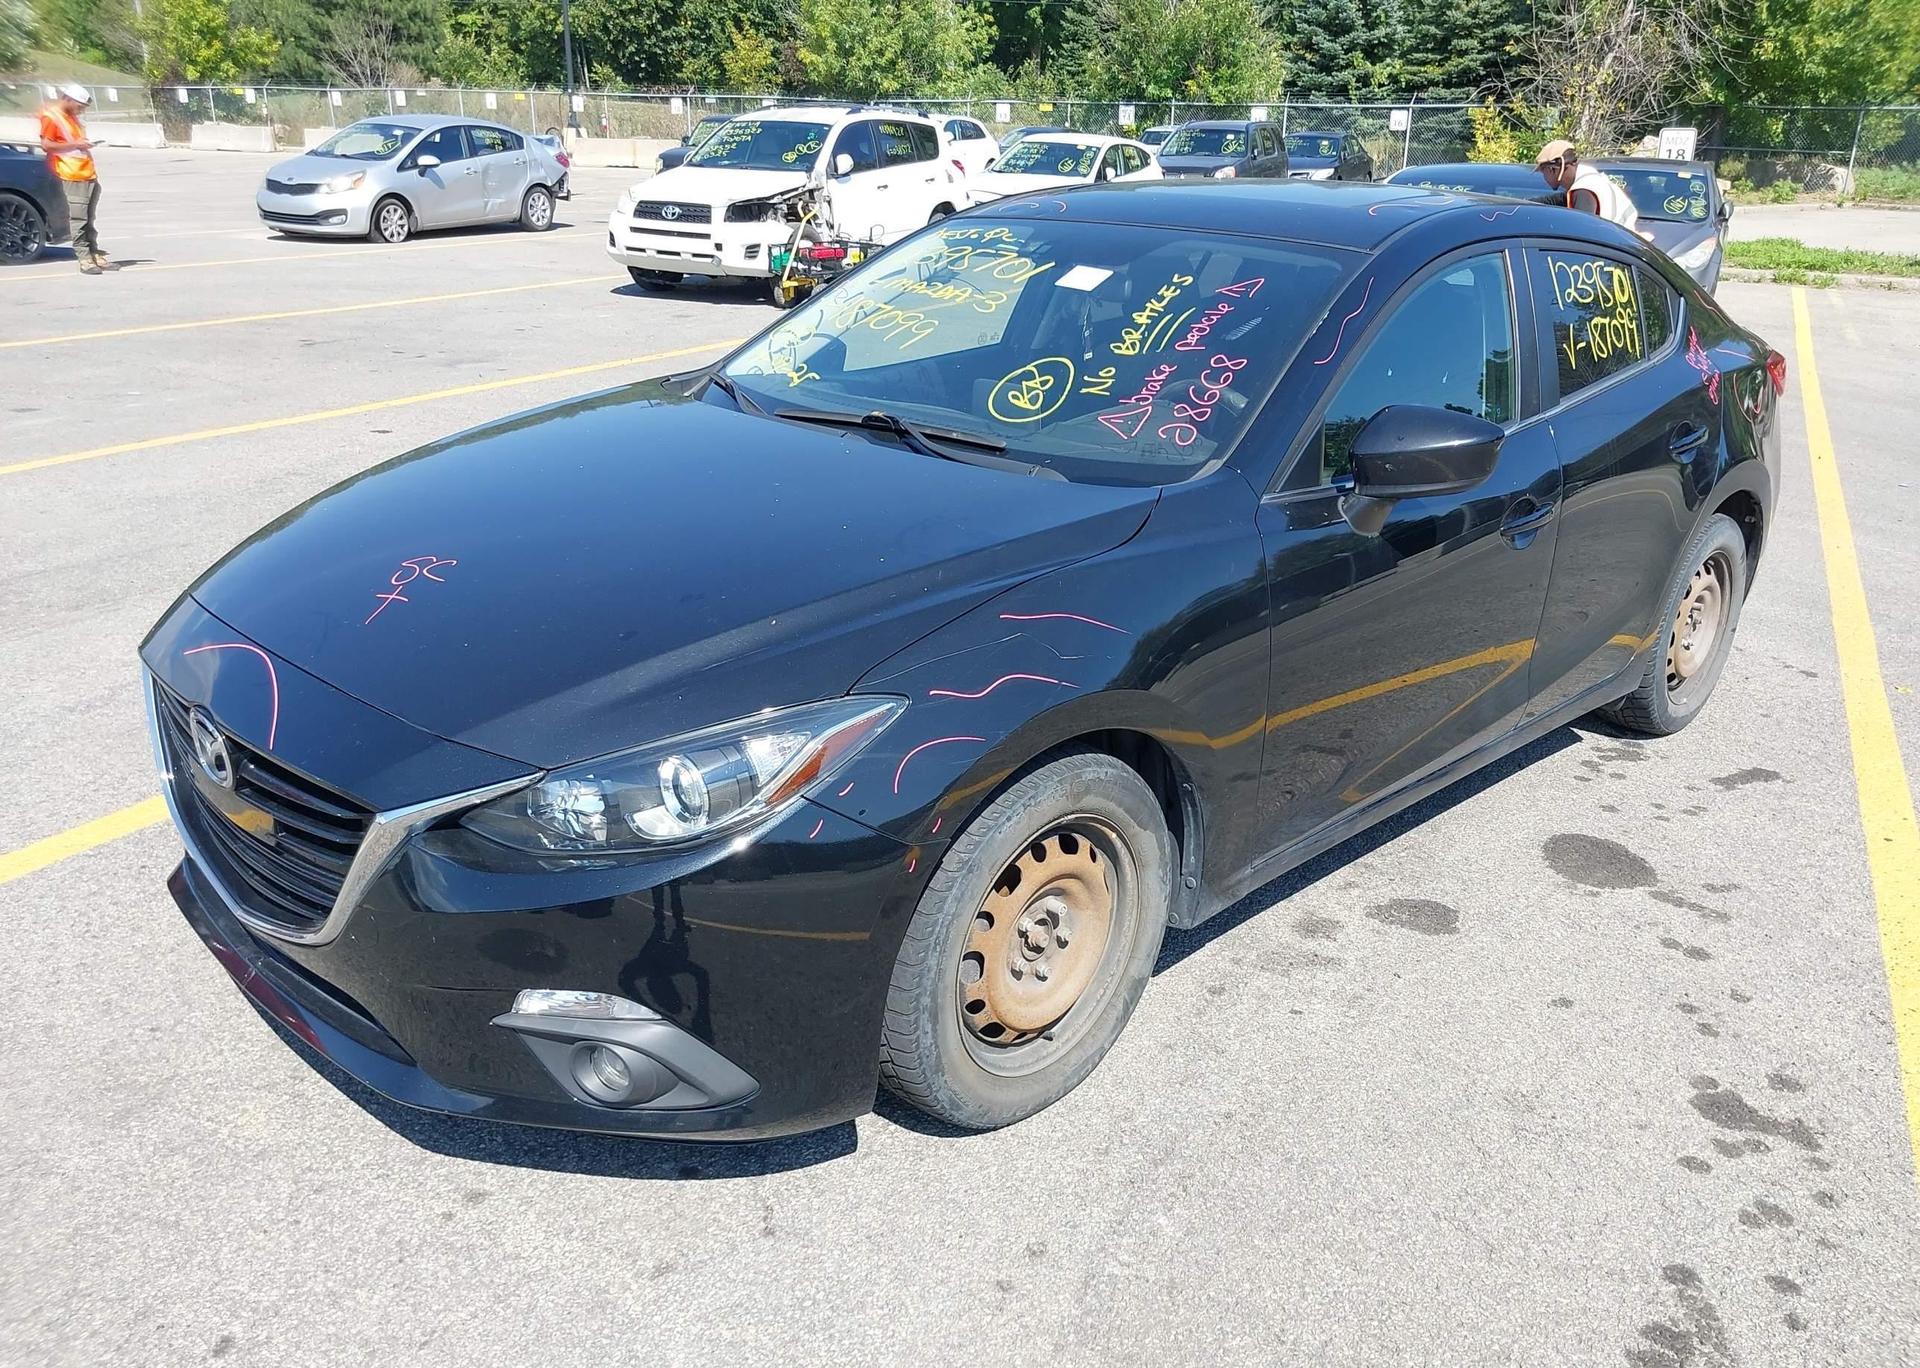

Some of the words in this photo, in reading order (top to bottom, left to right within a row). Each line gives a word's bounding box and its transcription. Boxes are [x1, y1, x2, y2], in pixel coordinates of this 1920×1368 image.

[1665, 148, 1686, 160] 18
[1547, 256, 1637, 311] 12395701
[1158, 353, 1249, 447] 28668
